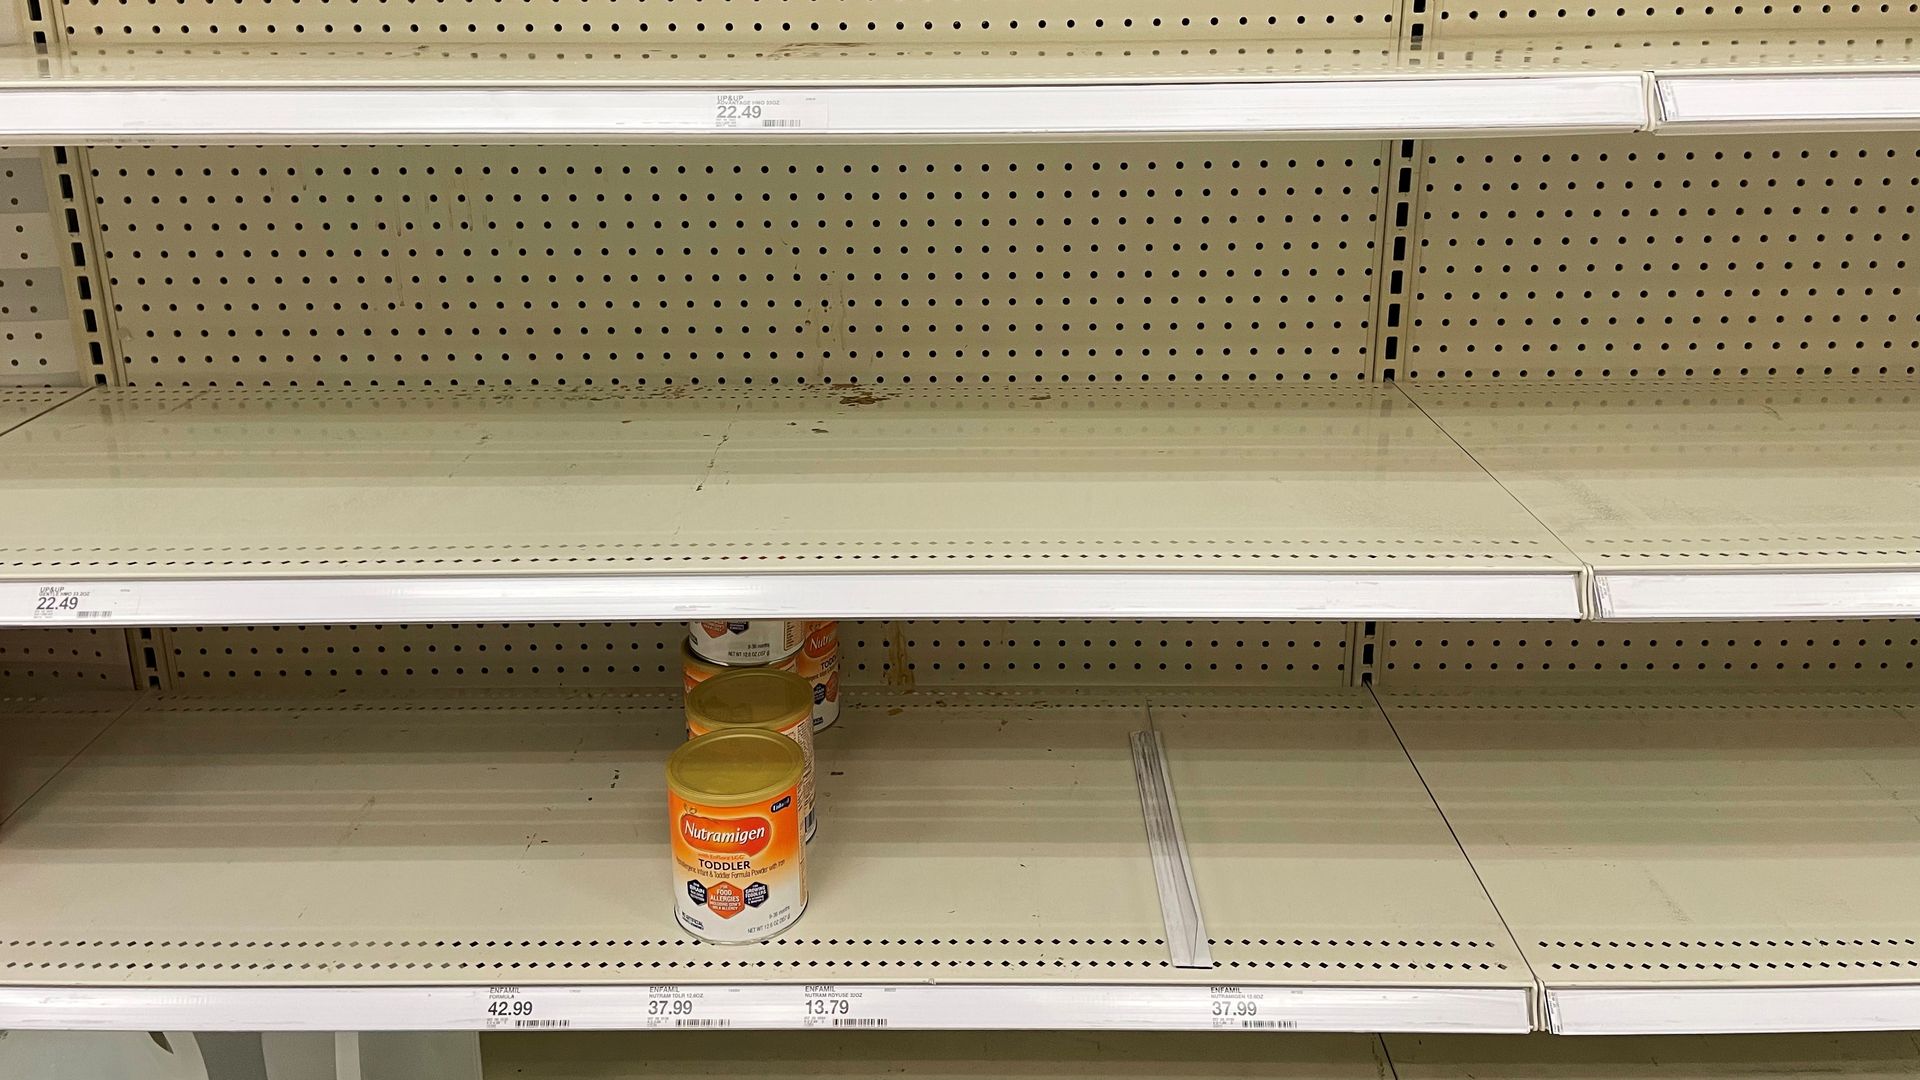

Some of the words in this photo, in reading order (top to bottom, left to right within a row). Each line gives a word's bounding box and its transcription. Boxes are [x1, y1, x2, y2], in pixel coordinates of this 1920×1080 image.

[717, 105, 761, 118] 22.49
[36, 597, 78, 610] 22.49
[684, 820, 765, 844] Nutramigen
[698, 858, 750, 870] TODDLER
[731, 870, 750, 878] Formula
[752, 866, 768, 876] Powder
[488, 1001, 532, 1016] 42.99
[648, 1000, 692, 1014] 37.99
[806, 1000, 849, 1014] 13.79
[1212, 1001, 1256, 1016] 37.99
